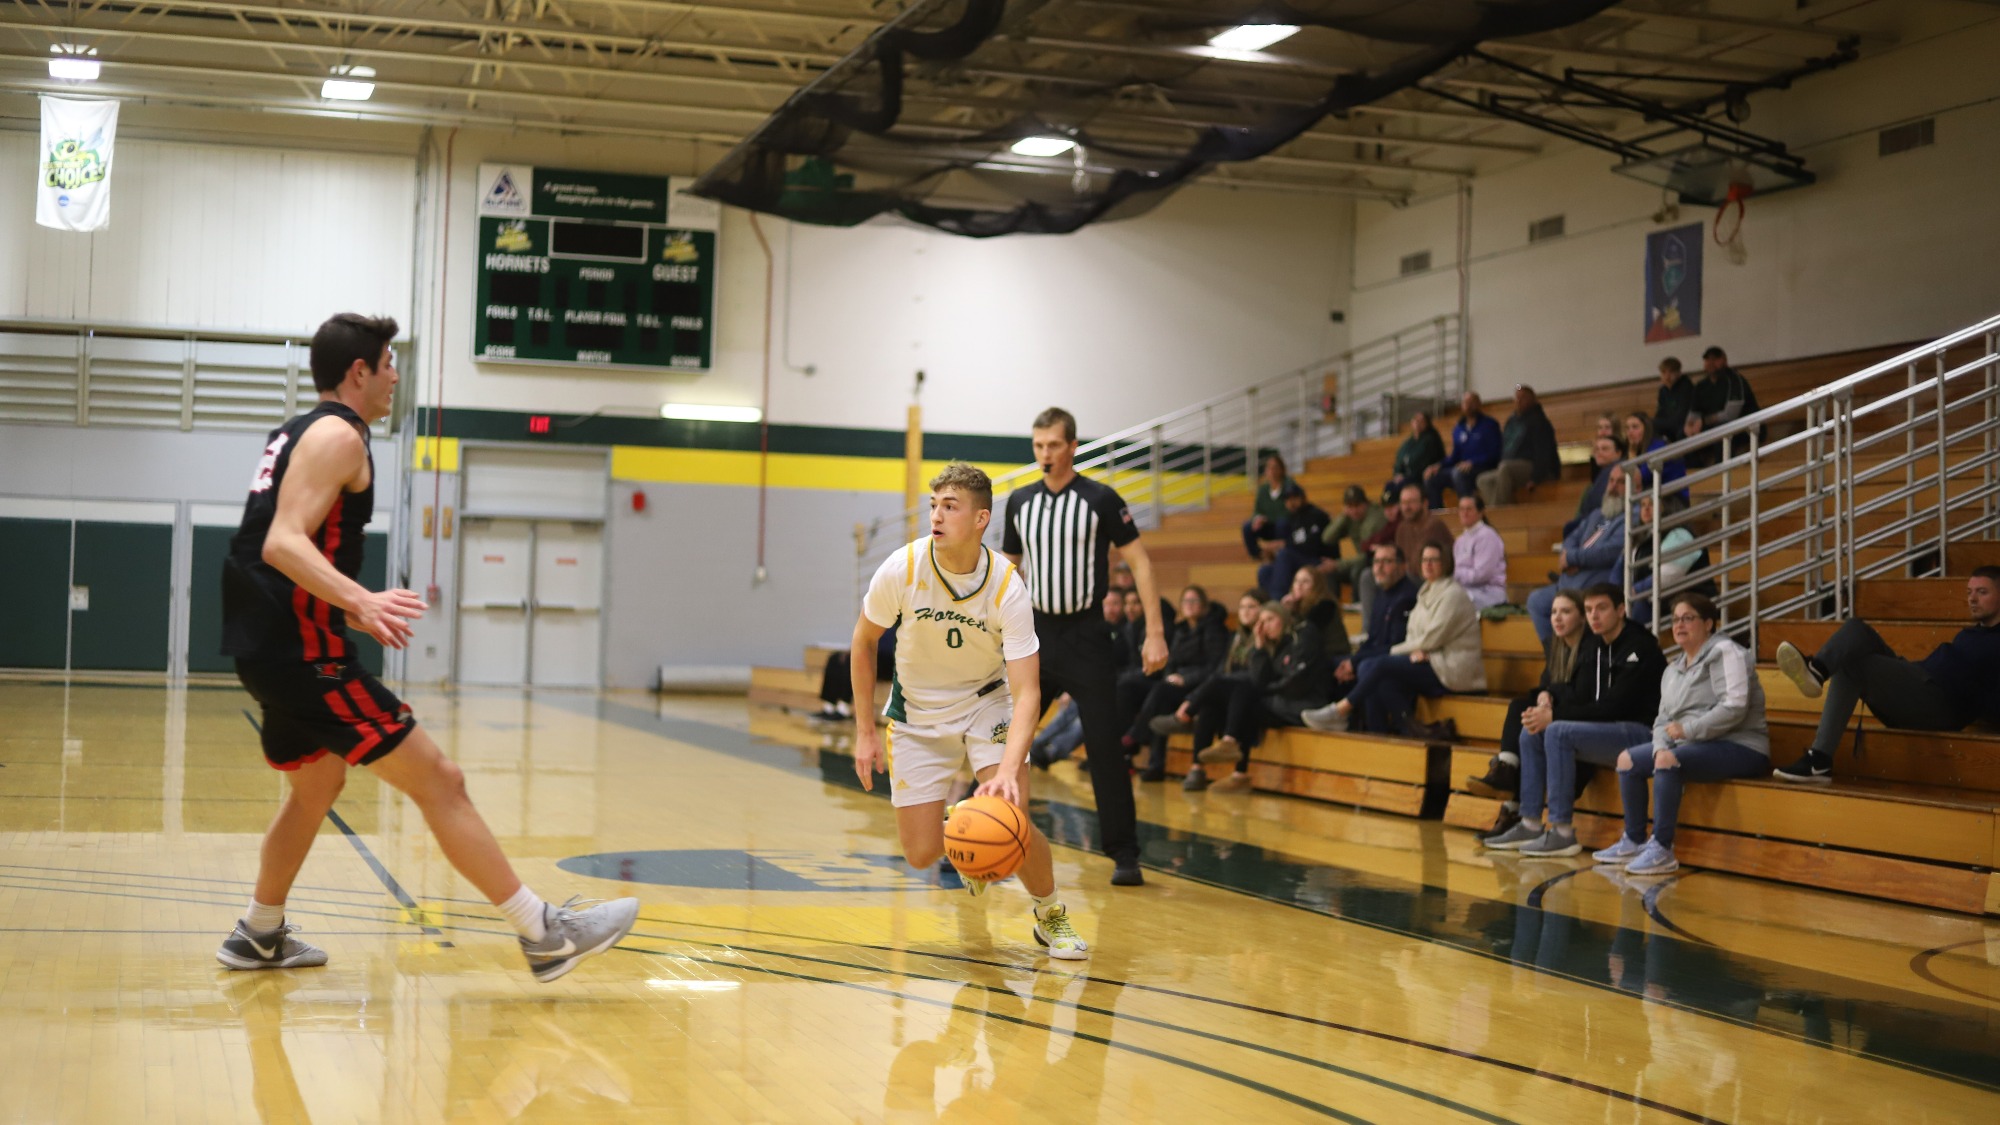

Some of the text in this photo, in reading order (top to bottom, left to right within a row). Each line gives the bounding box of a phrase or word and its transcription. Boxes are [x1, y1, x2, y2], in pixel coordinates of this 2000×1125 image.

[45, 161, 105, 189] CHOICES
[485, 253, 551, 274] HORNETS
[578, 267, 615, 281] PERIOD
[652, 263, 699, 283] GUEST
[486, 305, 518, 320] FOULS
[564, 309, 602, 325] PLAYER
[670, 315, 703, 331] FOULS
[946, 627, 963, 649] 0
